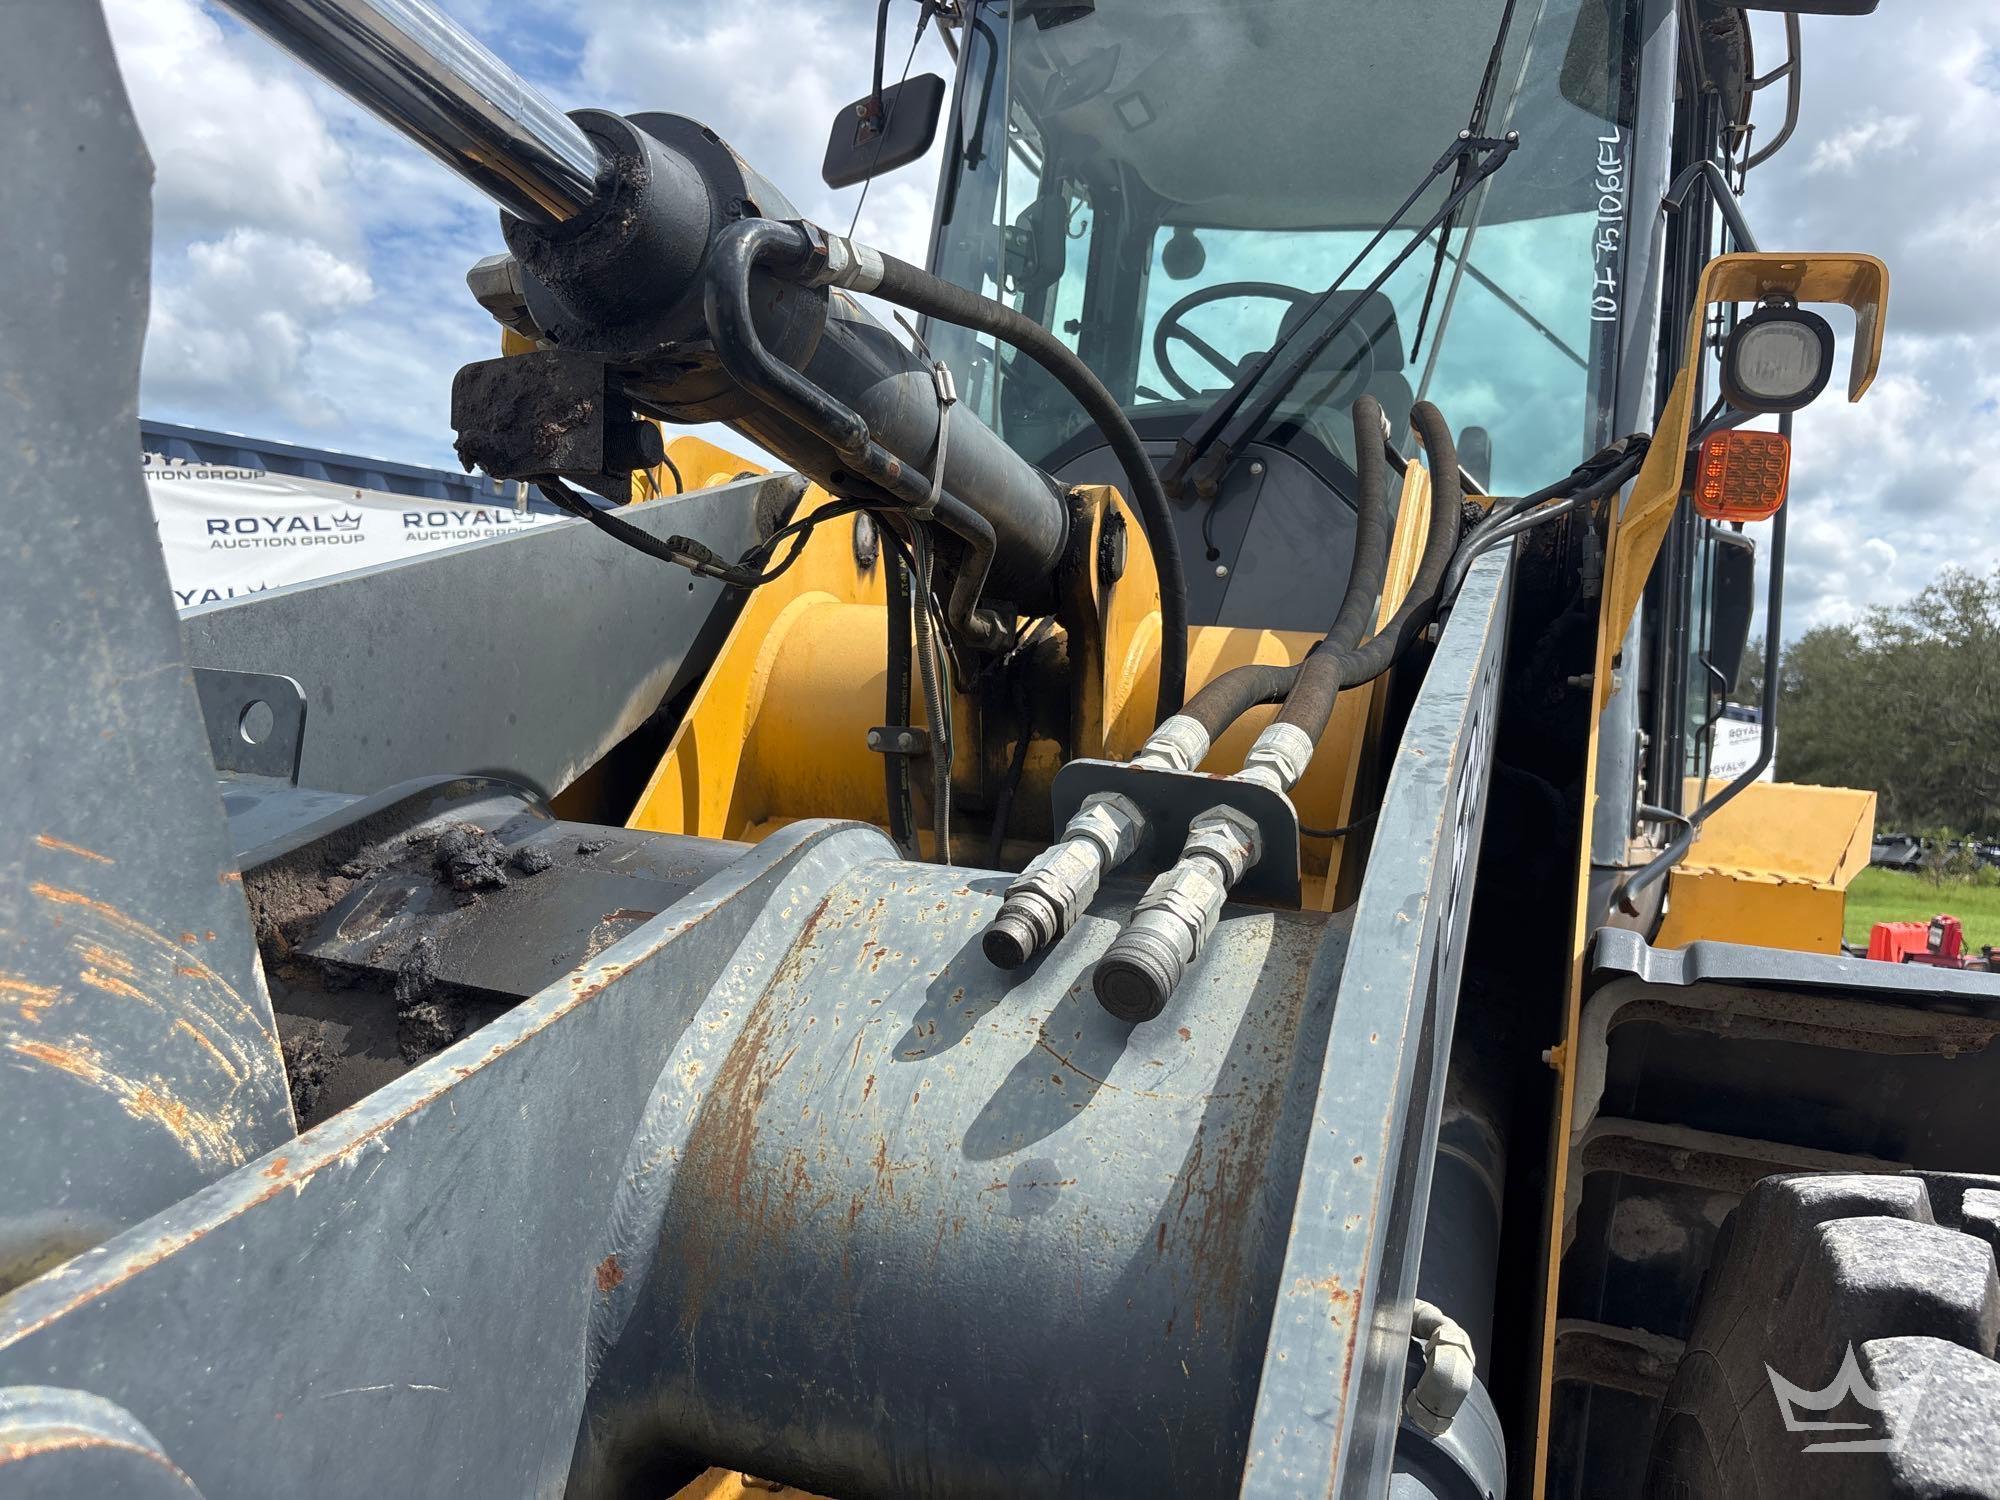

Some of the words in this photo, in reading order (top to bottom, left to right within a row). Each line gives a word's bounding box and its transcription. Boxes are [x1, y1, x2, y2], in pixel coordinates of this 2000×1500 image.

[144, 470, 191, 480] TION
[196, 470, 266, 480] GROUP
[207, 515, 332, 535] ROYAL
[403, 510, 511, 528] ROYAL
[210, 536, 297, 549] AUCTION
[301, 534, 366, 546] GROUP
[406, 529, 480, 541] AUCTION
